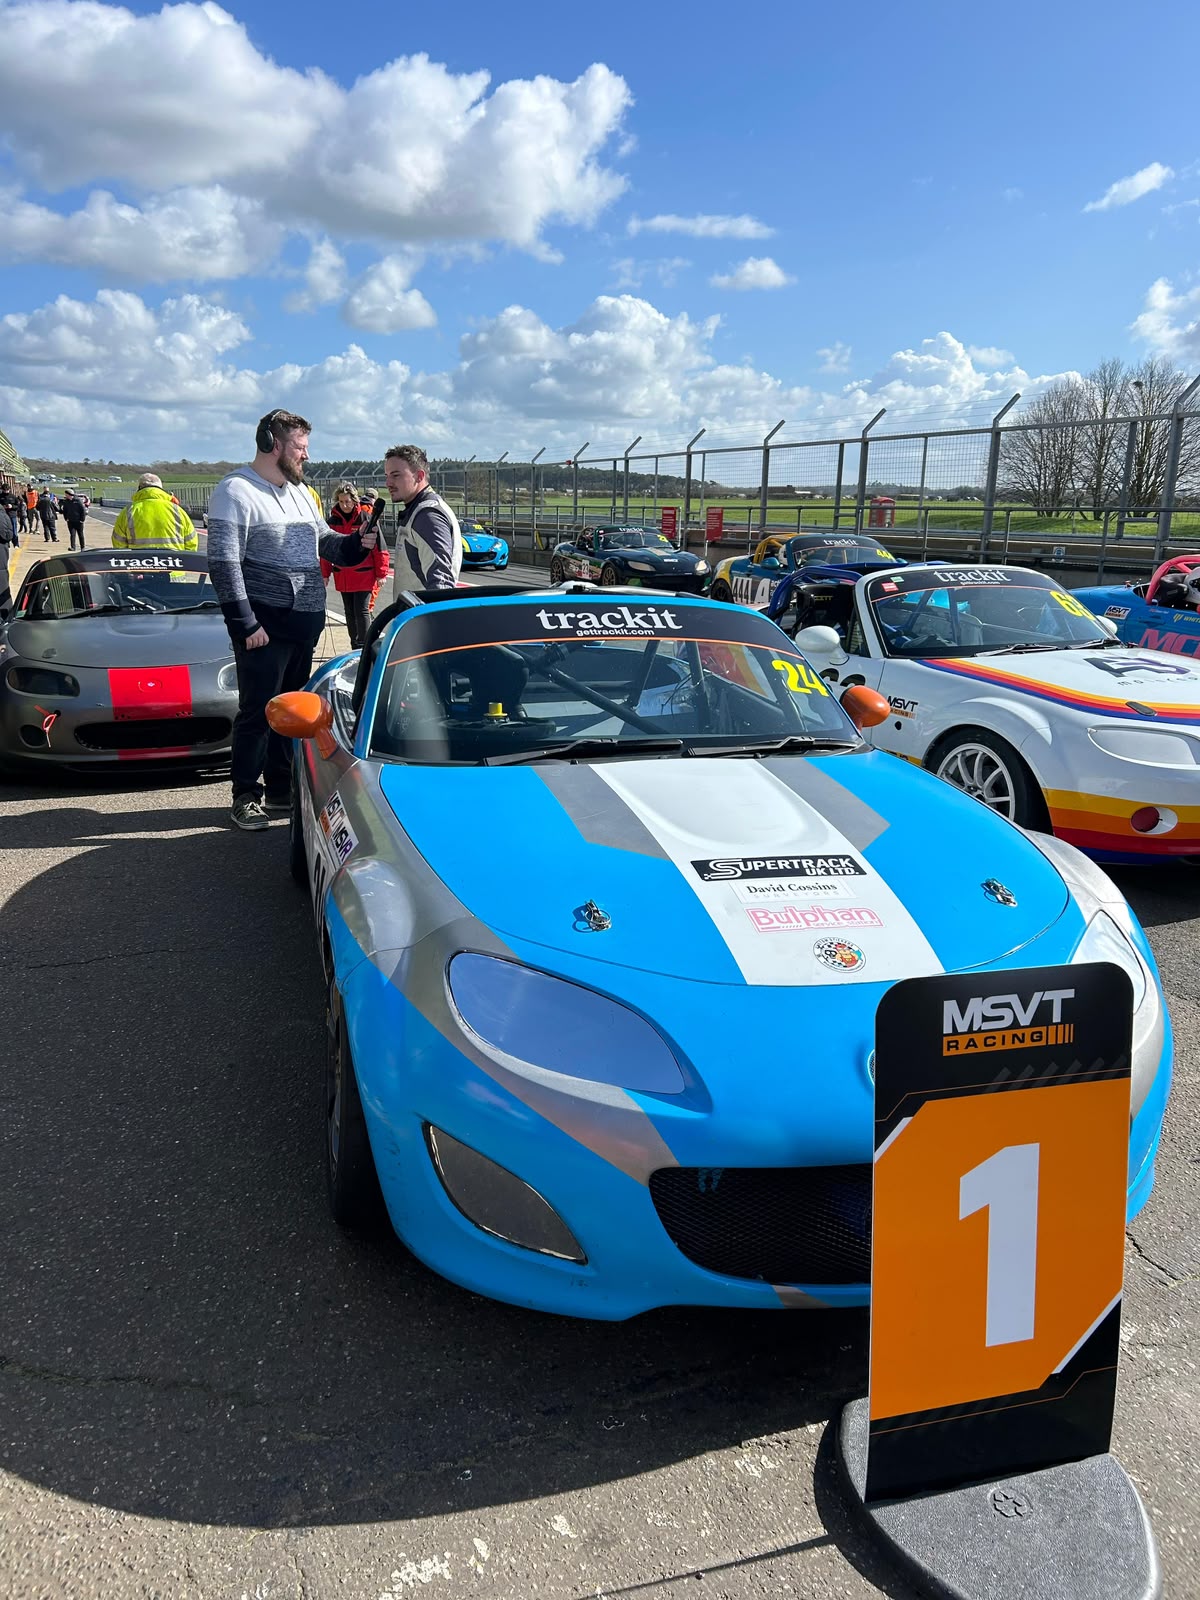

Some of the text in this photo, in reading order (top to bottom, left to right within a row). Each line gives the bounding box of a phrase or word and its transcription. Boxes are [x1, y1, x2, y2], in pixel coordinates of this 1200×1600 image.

[109, 556, 184, 568] trackit
[933, 569, 1012, 582] trackit
[536, 606, 683, 630] trackit
[576, 629, 655, 637] gettrackit.com
[771, 660, 830, 697] 24
[886, 696, 918, 712] MSVT
[705, 856, 852, 879] SUPERTRACK
[805, 866, 860, 876] UK LTD.
[746, 882, 838, 894] David Cossins
[753, 891, 841, 899] SURVEYORS
[750, 907, 877, 927] Bulphan
[943, 988, 1076, 1034] MSVT
[946, 1030, 1044, 1052] RACING
[959, 1142, 1040, 1347] 1
